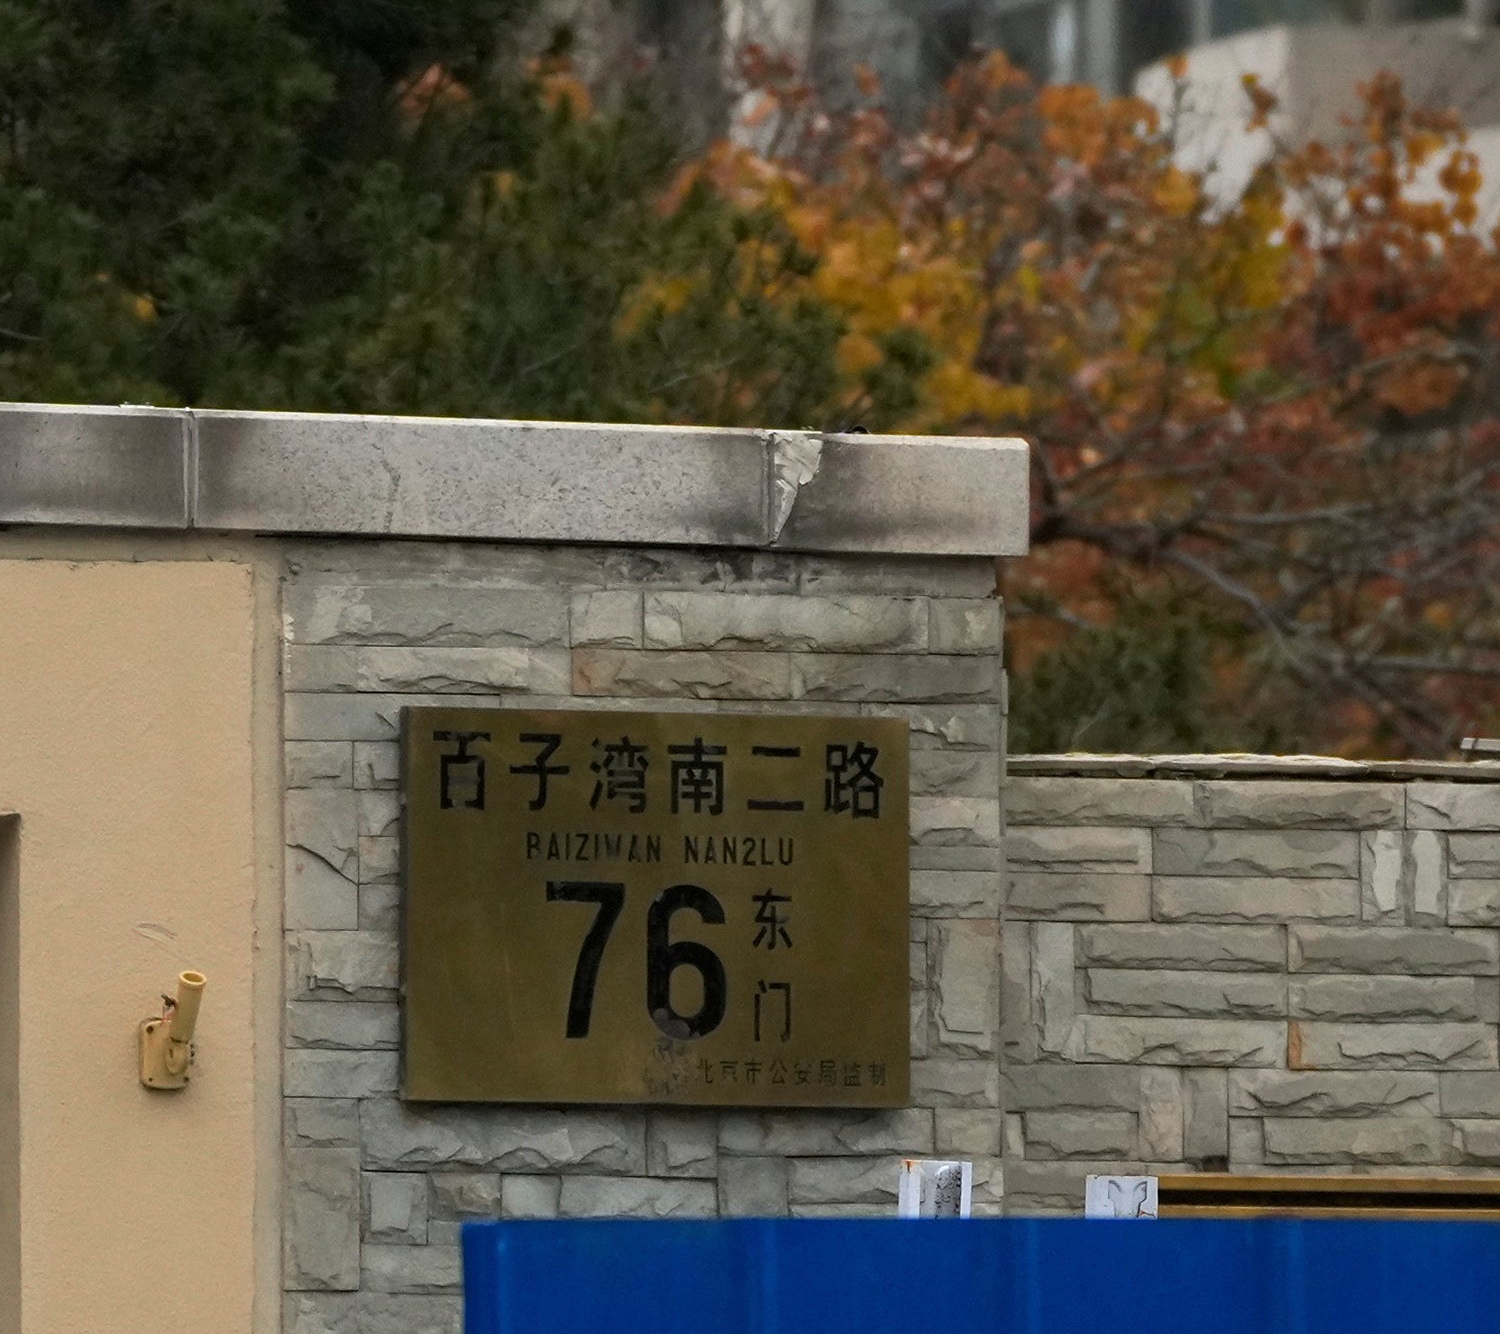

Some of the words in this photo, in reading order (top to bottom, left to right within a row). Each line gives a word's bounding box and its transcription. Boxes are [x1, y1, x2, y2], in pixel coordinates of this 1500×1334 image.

[432, 729, 885, 820] 百子湾南二路
[526, 831, 661, 864] BAIZIWAN
[684, 835, 794, 867] NAN2LU
[545, 880, 728, 1041] 76
[751, 887, 793, 1044] 东门
